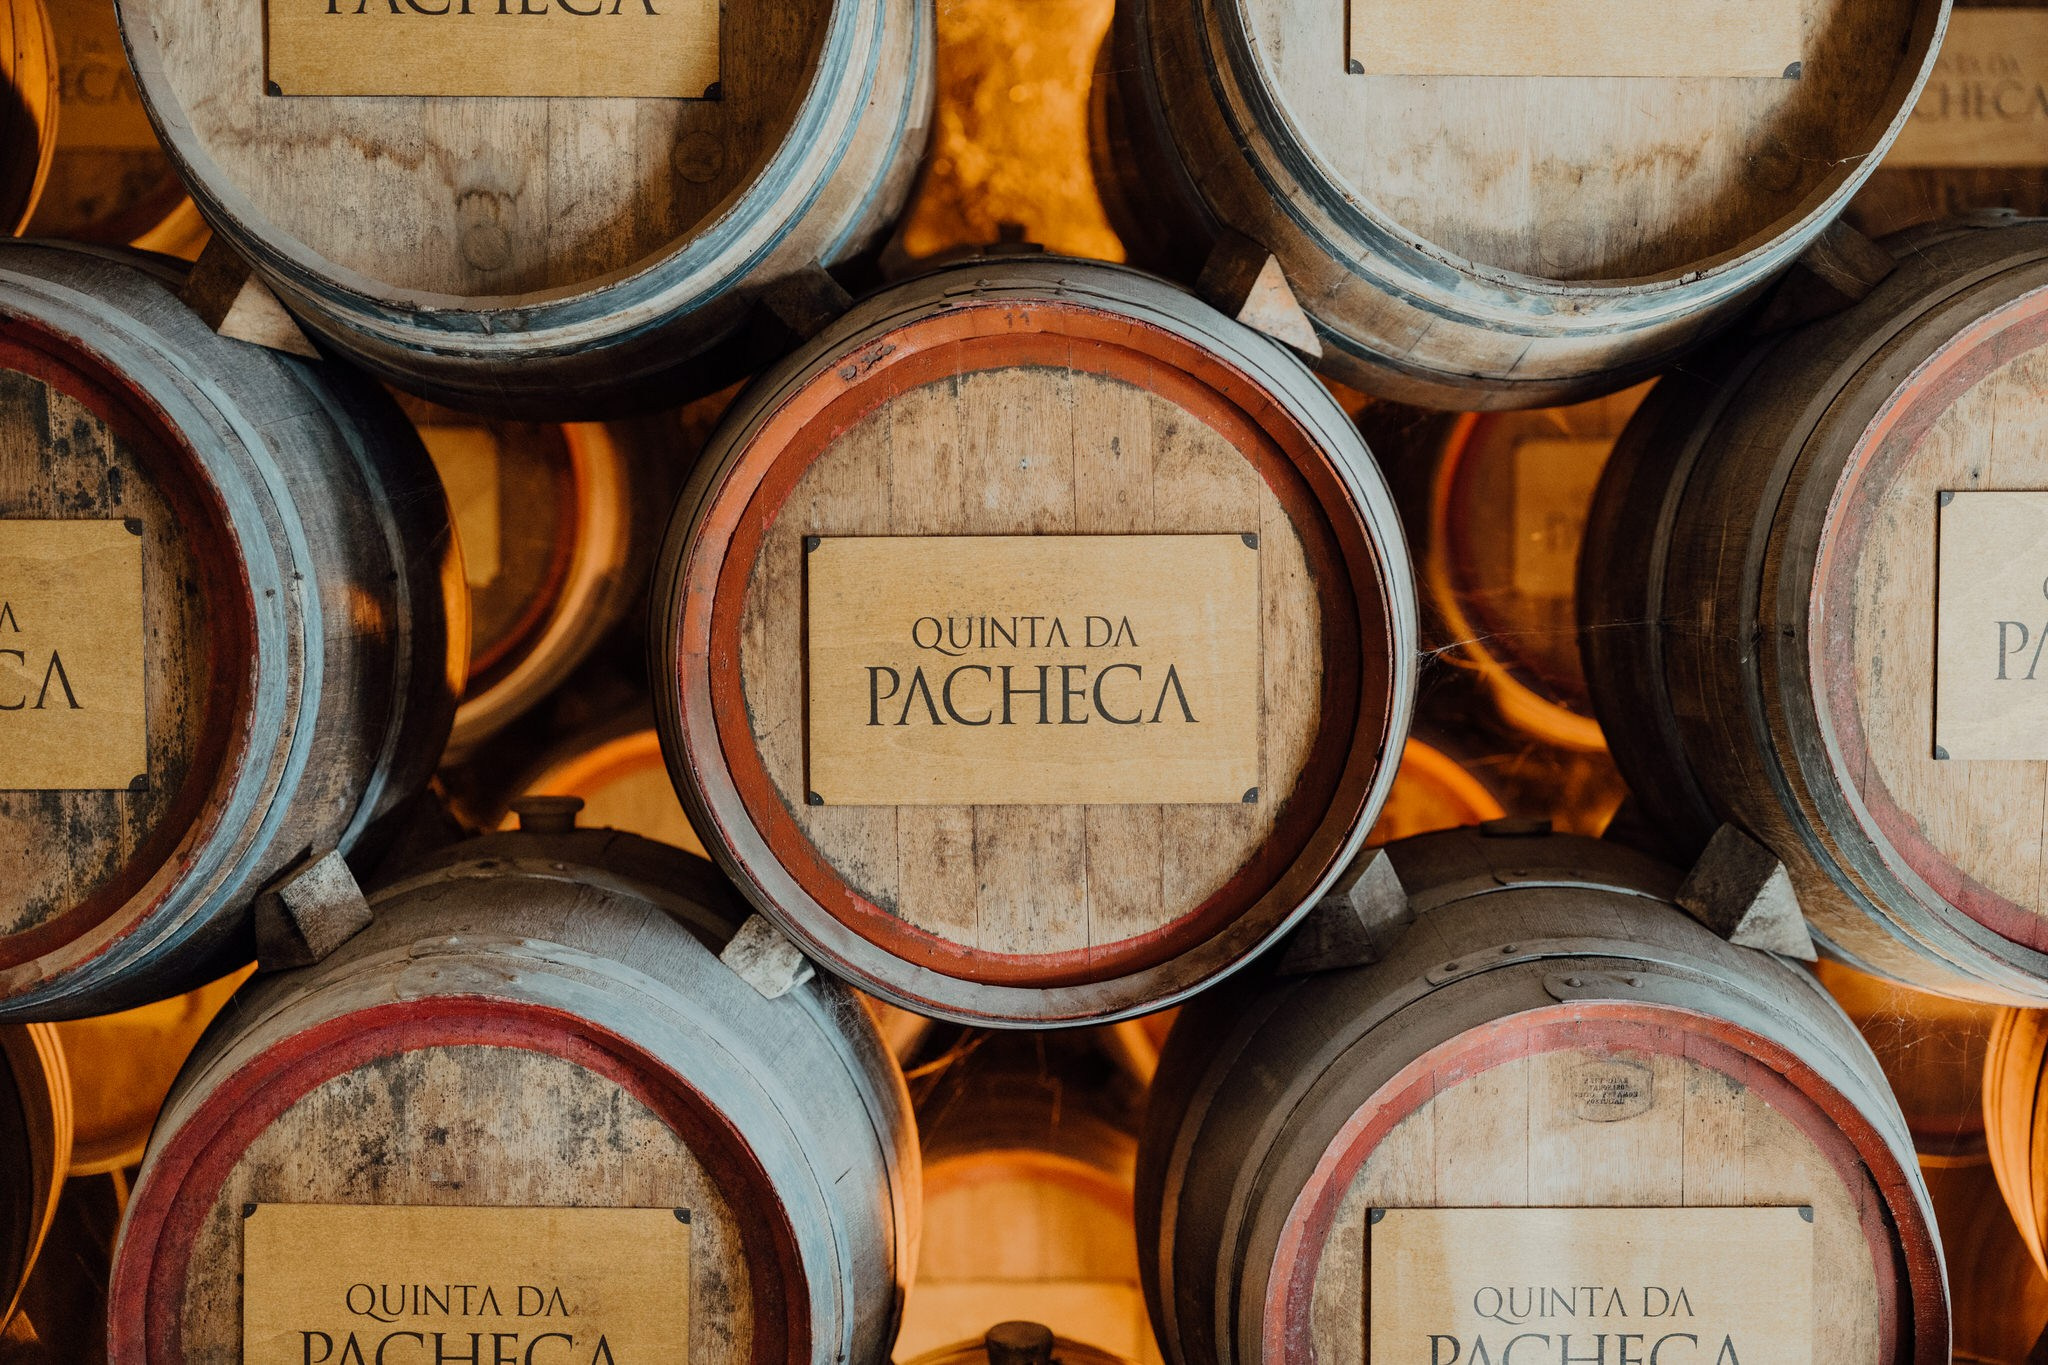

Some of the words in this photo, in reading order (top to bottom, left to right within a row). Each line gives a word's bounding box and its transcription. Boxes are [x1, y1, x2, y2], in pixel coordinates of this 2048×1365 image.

[912, 616, 1071, 656] QUINTA
[1084, 615, 1139, 648] DA
[864, 663, 1200, 726] PACHECA
[346, 1284, 503, 1323] QUINTA
[516, 1285, 570, 1317] DA
[1473, 1286, 1629, 1325] QUINTA
[1643, 1286, 1695, 1317] DA
